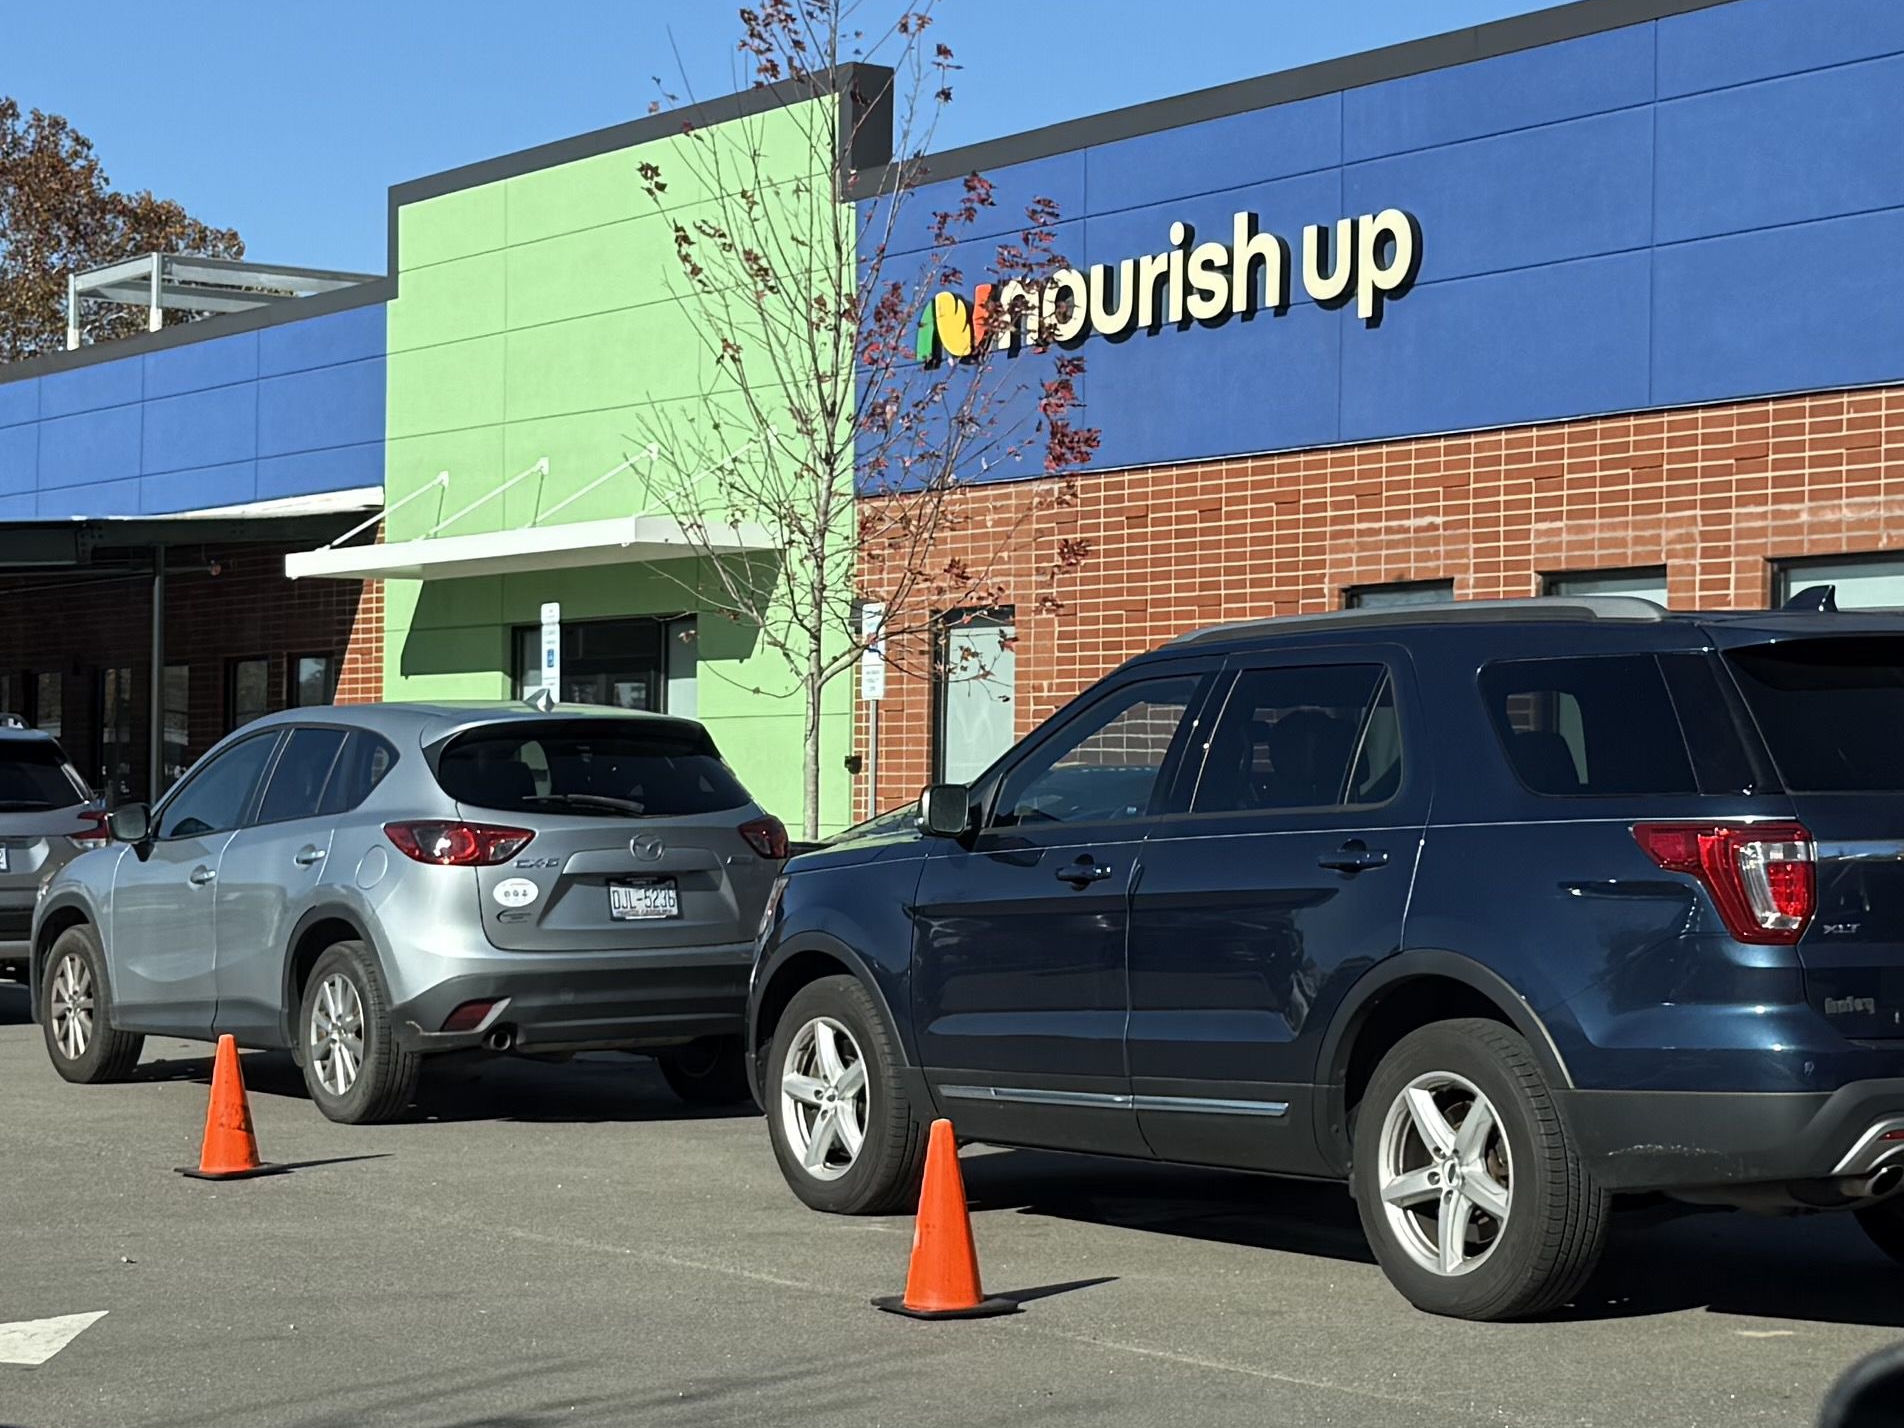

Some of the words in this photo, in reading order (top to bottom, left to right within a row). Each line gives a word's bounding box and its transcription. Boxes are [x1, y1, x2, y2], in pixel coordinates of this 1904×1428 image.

[996, 210, 1282, 349] nourish
[1301, 207, 1414, 319] up
[1823, 923, 1861, 934] XLT
